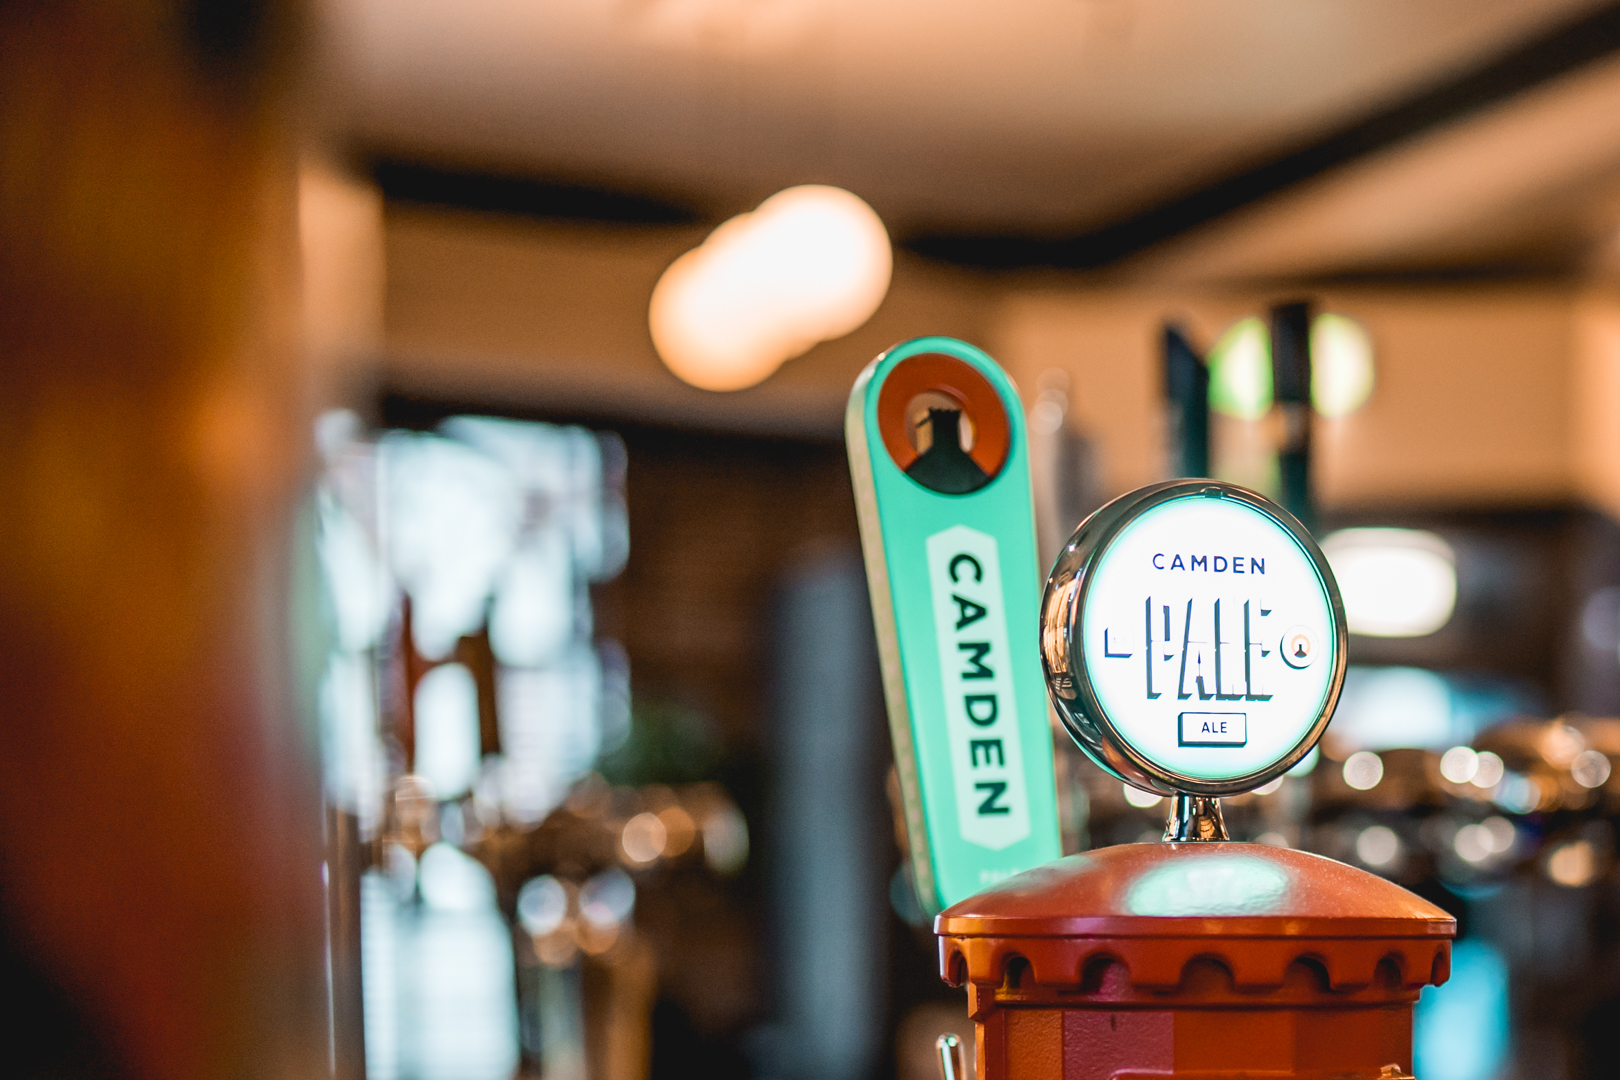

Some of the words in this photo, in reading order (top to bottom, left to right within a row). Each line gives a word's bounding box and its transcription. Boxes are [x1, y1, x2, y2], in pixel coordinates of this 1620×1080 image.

[1152, 553, 1266, 575] CAMDEN
[1145, 596, 1274, 702] PALE
[948, 553, 1010, 815] CAMDEN
[1201, 721, 1228, 734] ALE
